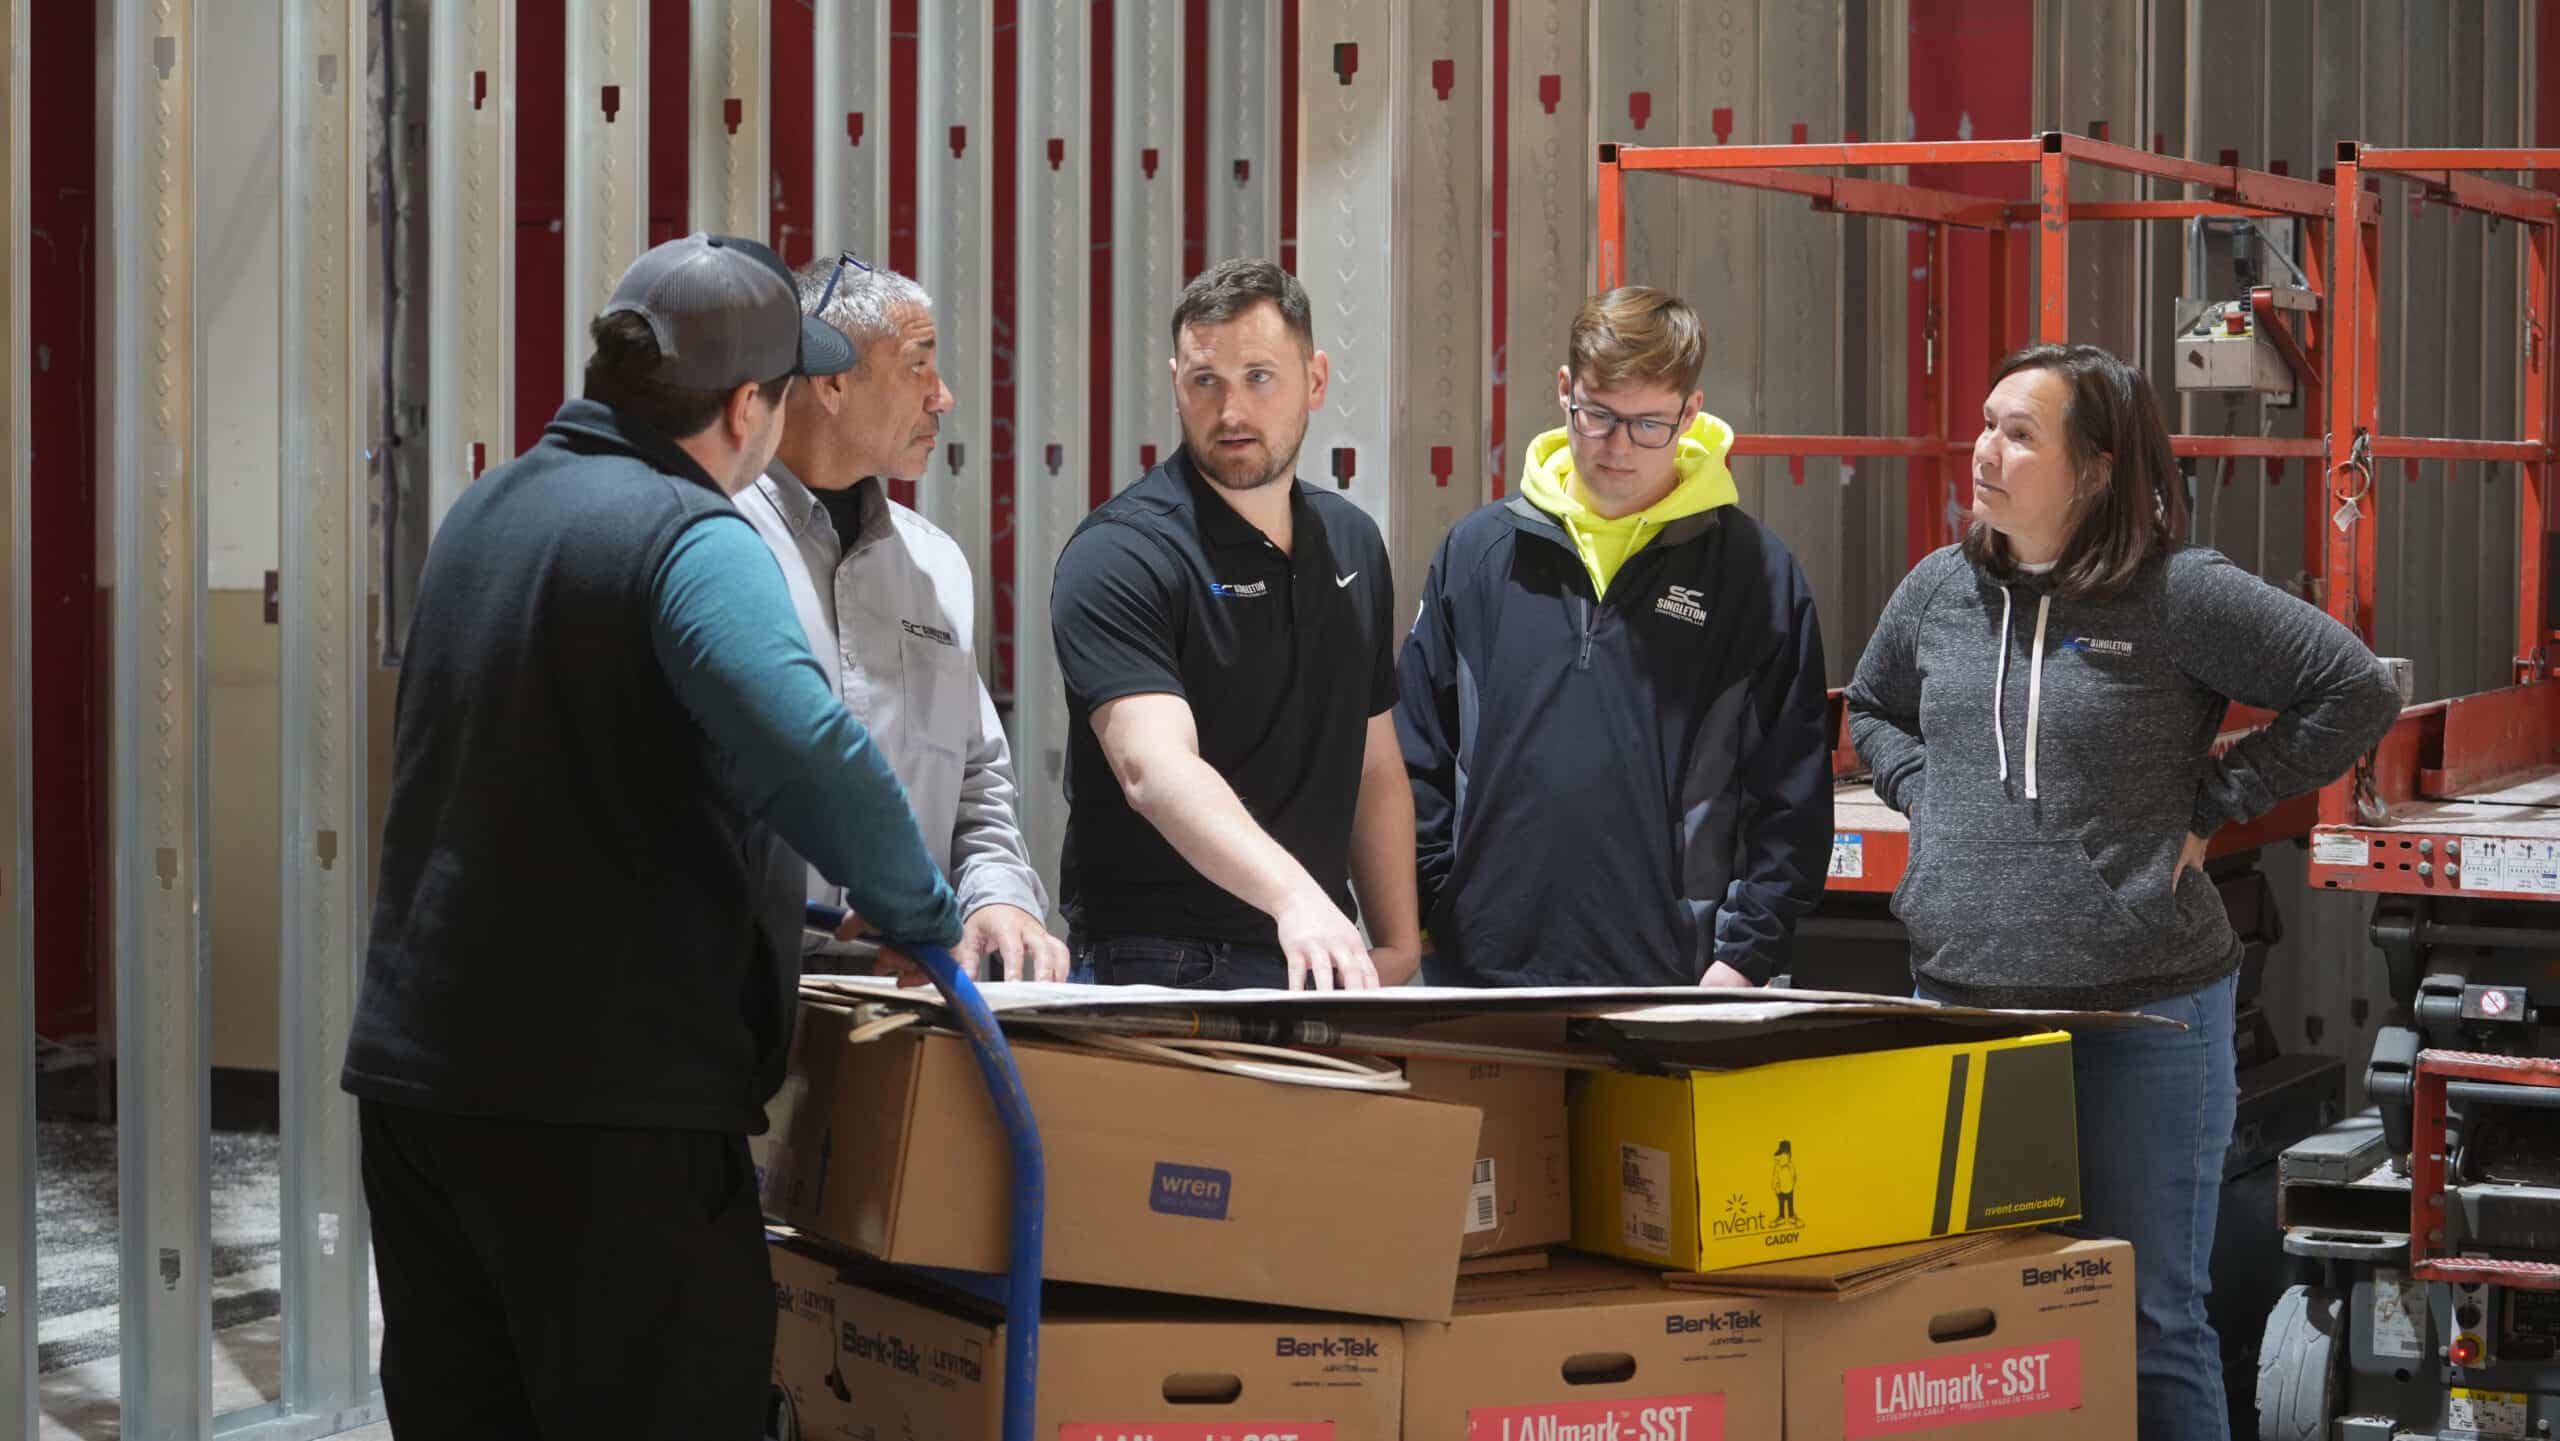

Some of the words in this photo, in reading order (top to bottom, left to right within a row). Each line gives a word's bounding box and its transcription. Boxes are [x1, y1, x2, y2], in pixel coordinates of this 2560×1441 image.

[1656, 597, 1707, 621] SINGLETON
[2089, 638, 2134, 653] SINGLETON
[1161, 1175, 1222, 1199] wren
[1984, 1195, 2066, 1217] nvent.com/caddy
[1764, 1231, 1800, 1247] CADDY
[2022, 1256, 2113, 1288] Berk-Tek
[1665, 1309, 1763, 1335] Berk-Tek
[841, 1320, 921, 1377] Berk-Tek
[1276, 1336, 1379, 1358] Berk-Tek
